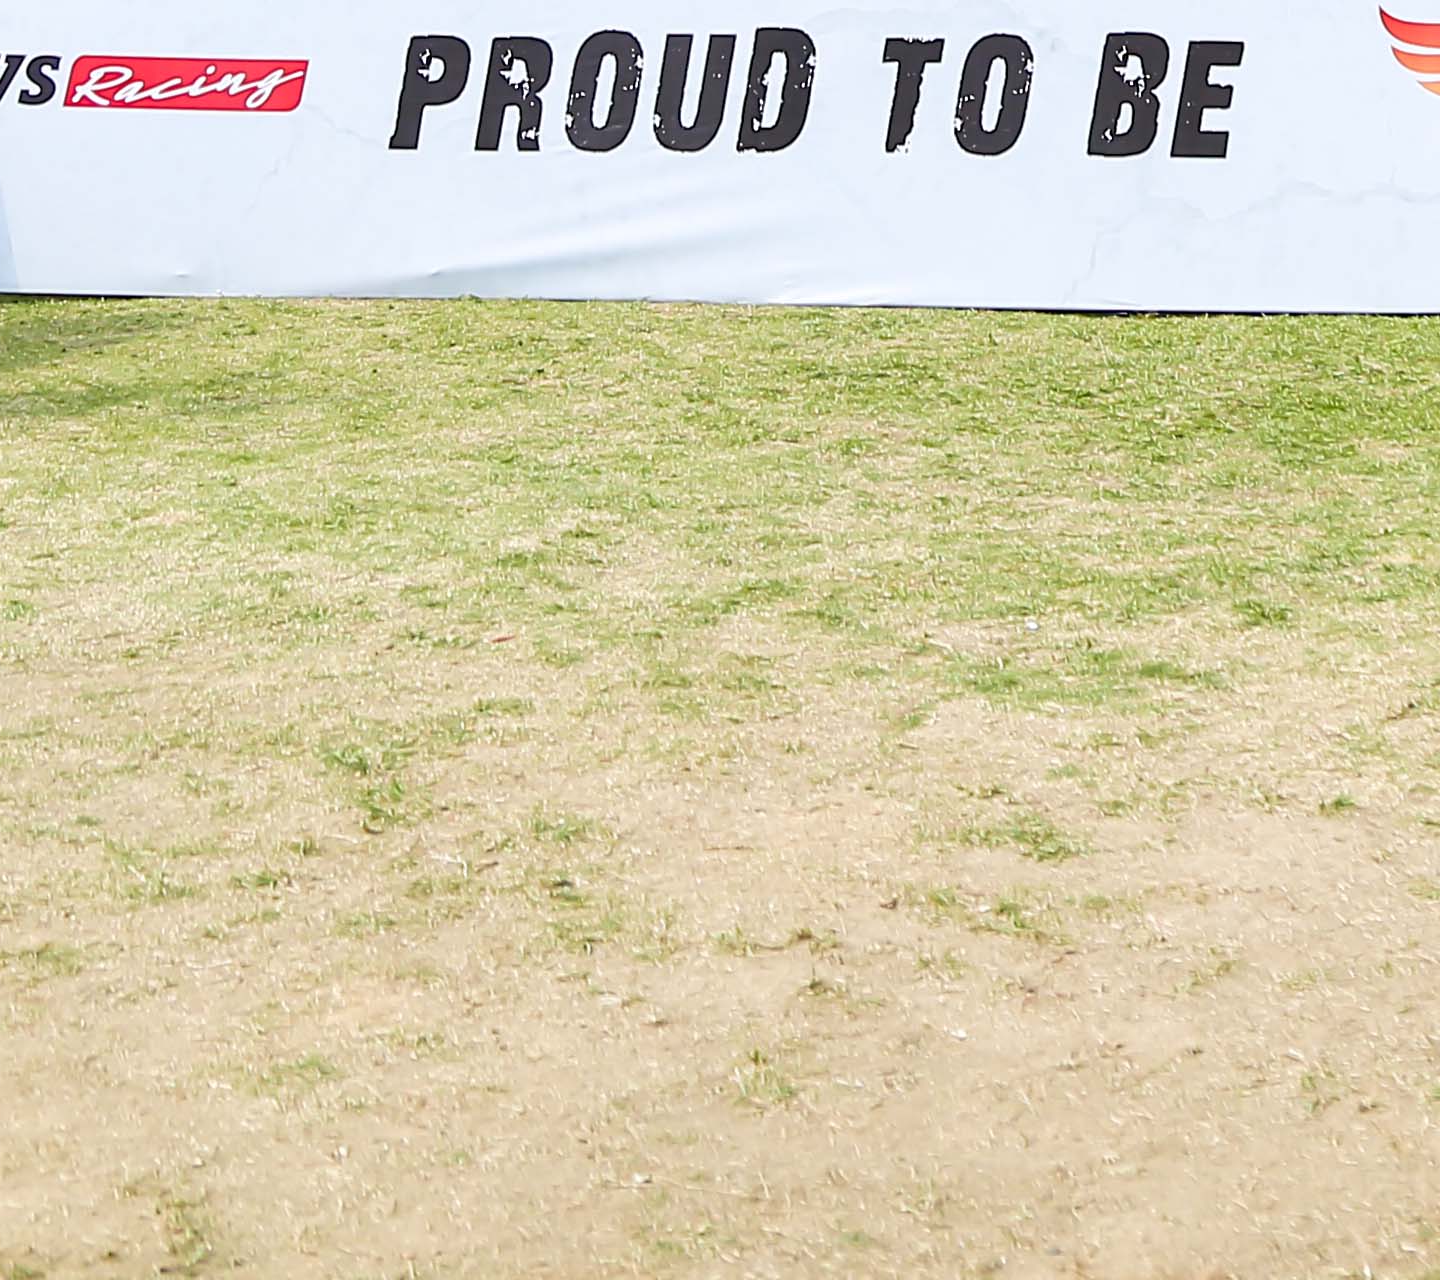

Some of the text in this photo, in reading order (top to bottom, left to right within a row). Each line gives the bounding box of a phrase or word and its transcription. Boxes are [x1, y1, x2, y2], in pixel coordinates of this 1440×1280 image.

[71, 64, 304, 110] Racing
[389, 27, 1245, 158] PROUD TO BE
